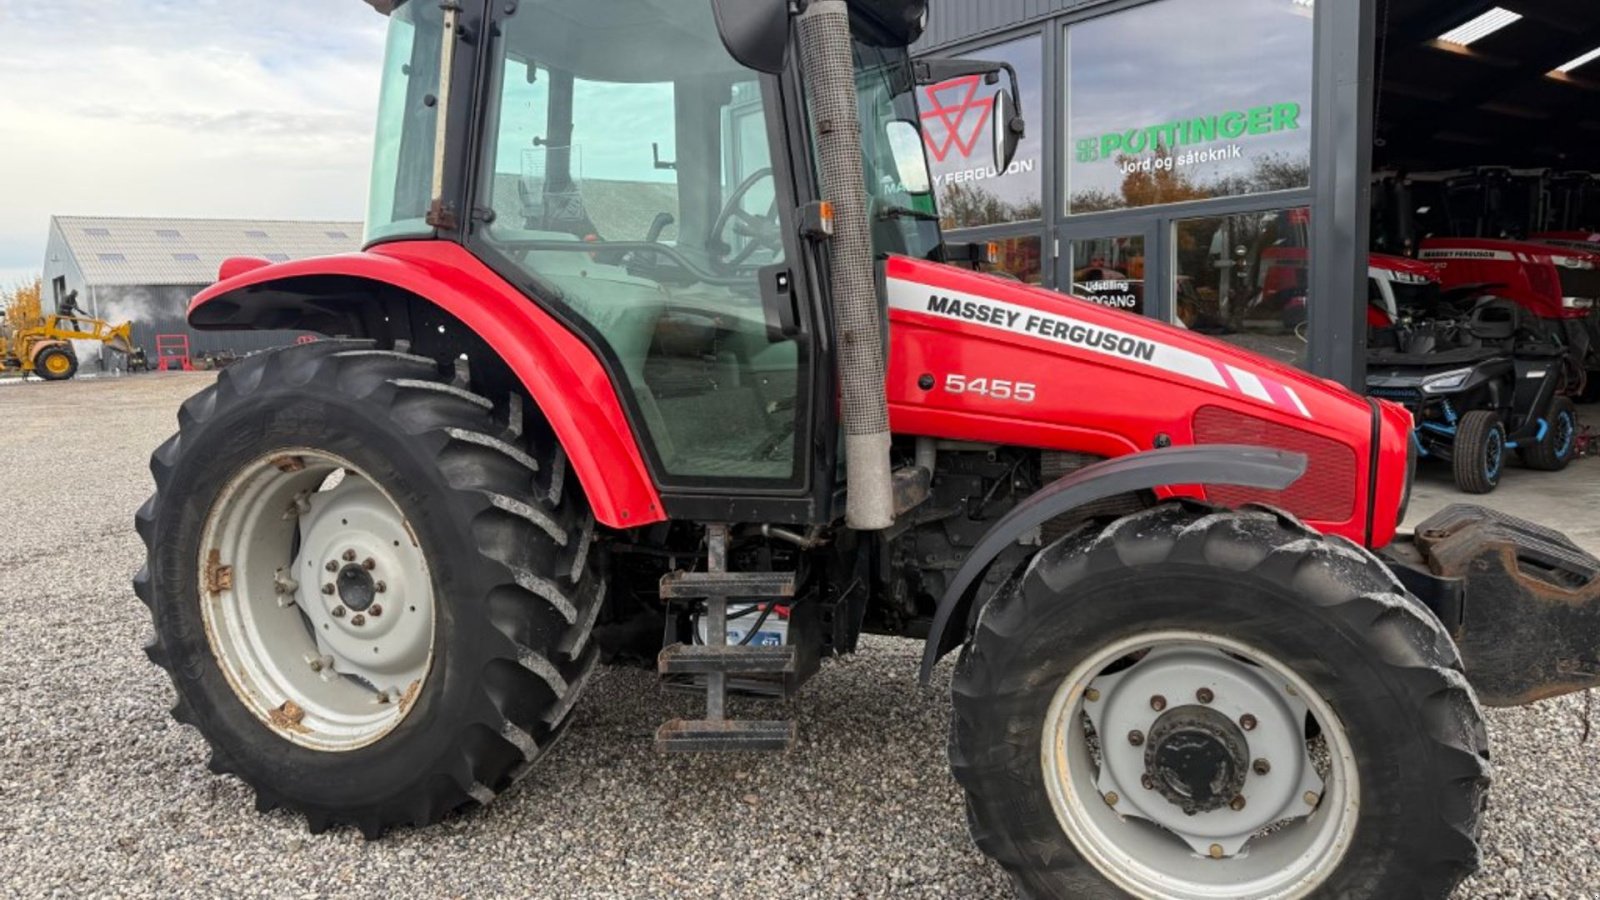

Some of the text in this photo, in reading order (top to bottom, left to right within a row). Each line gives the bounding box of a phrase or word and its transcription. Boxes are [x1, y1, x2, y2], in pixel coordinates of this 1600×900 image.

[945, 159, 1034, 185] FERGUON
[1119, 143, 1241, 175] Jord og såteknik
[926, 294, 1156, 361] MASSEY FERGUSON
[944, 374, 1036, 403] 5455
